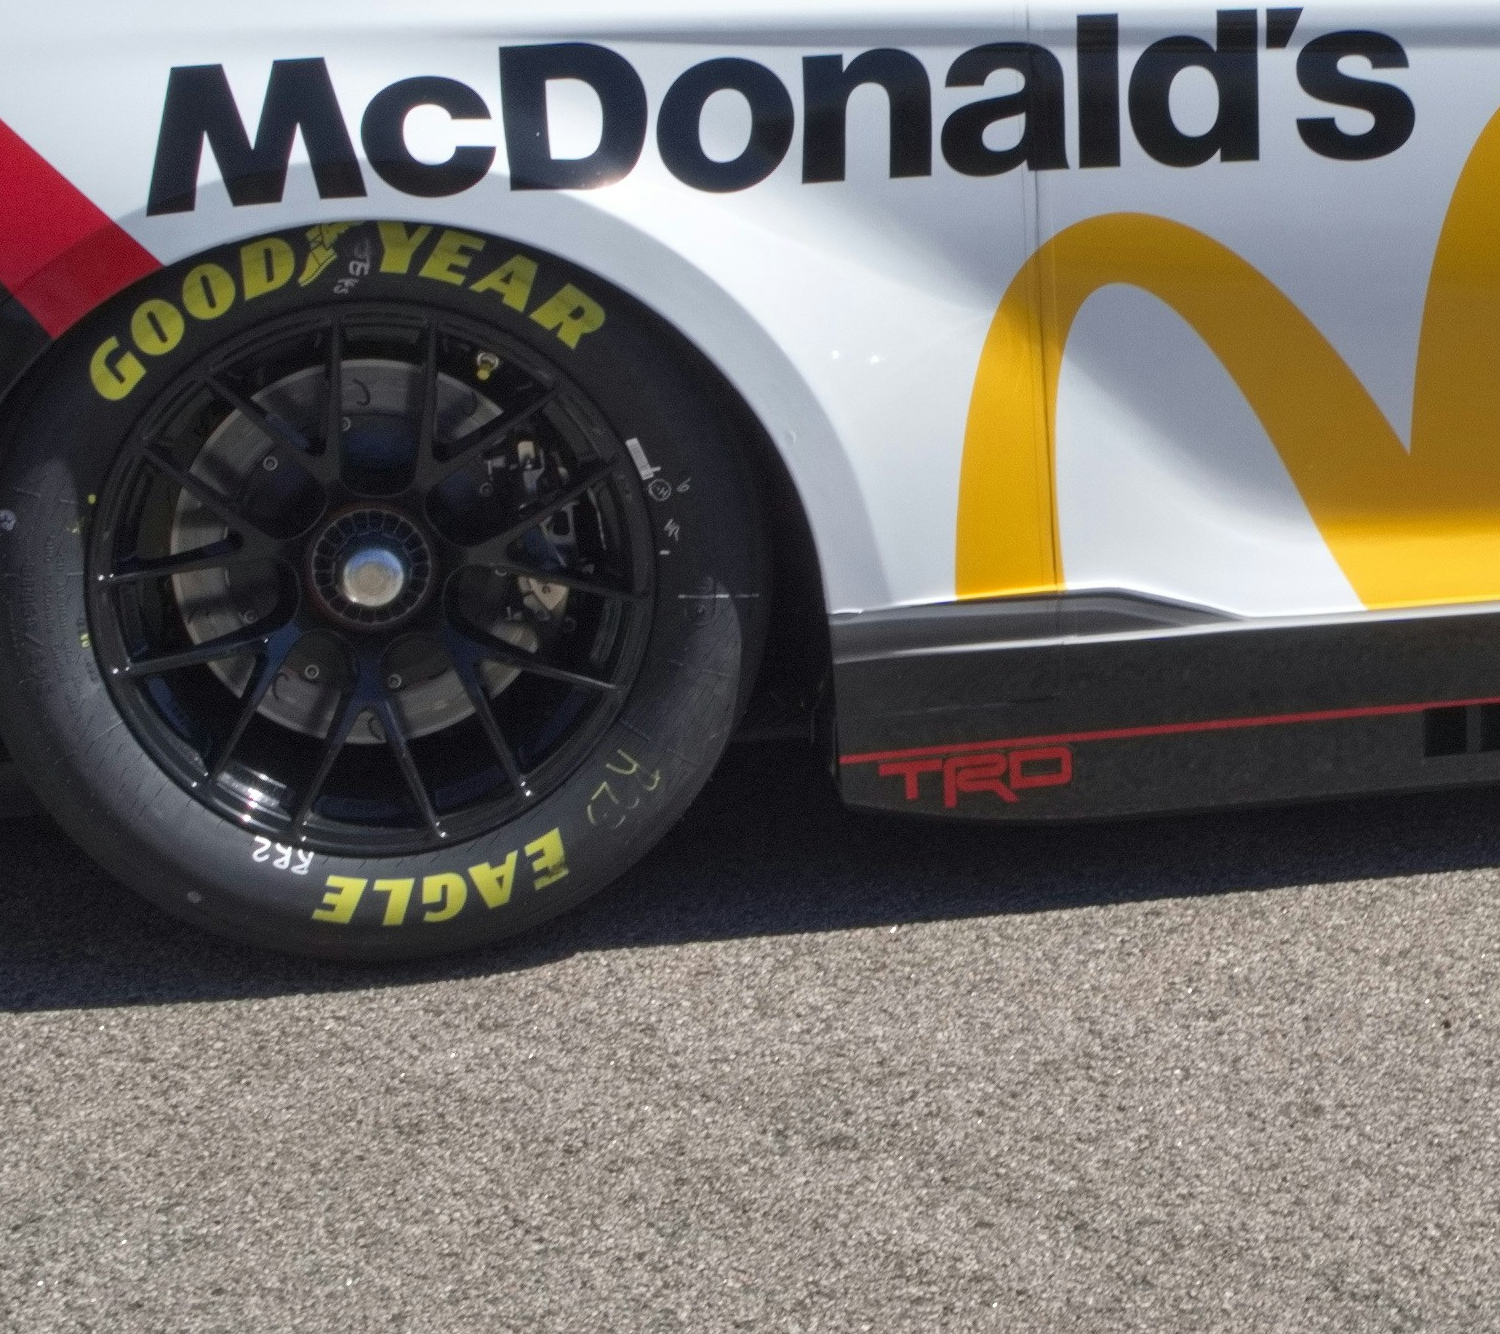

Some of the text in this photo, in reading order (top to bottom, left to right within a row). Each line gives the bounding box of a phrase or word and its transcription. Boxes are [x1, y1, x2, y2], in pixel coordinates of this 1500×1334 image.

[146, 7, 1417, 217] McDonald's
[877, 746, 1073, 809] TRD
[311, 827, 570, 927] EAGLE
